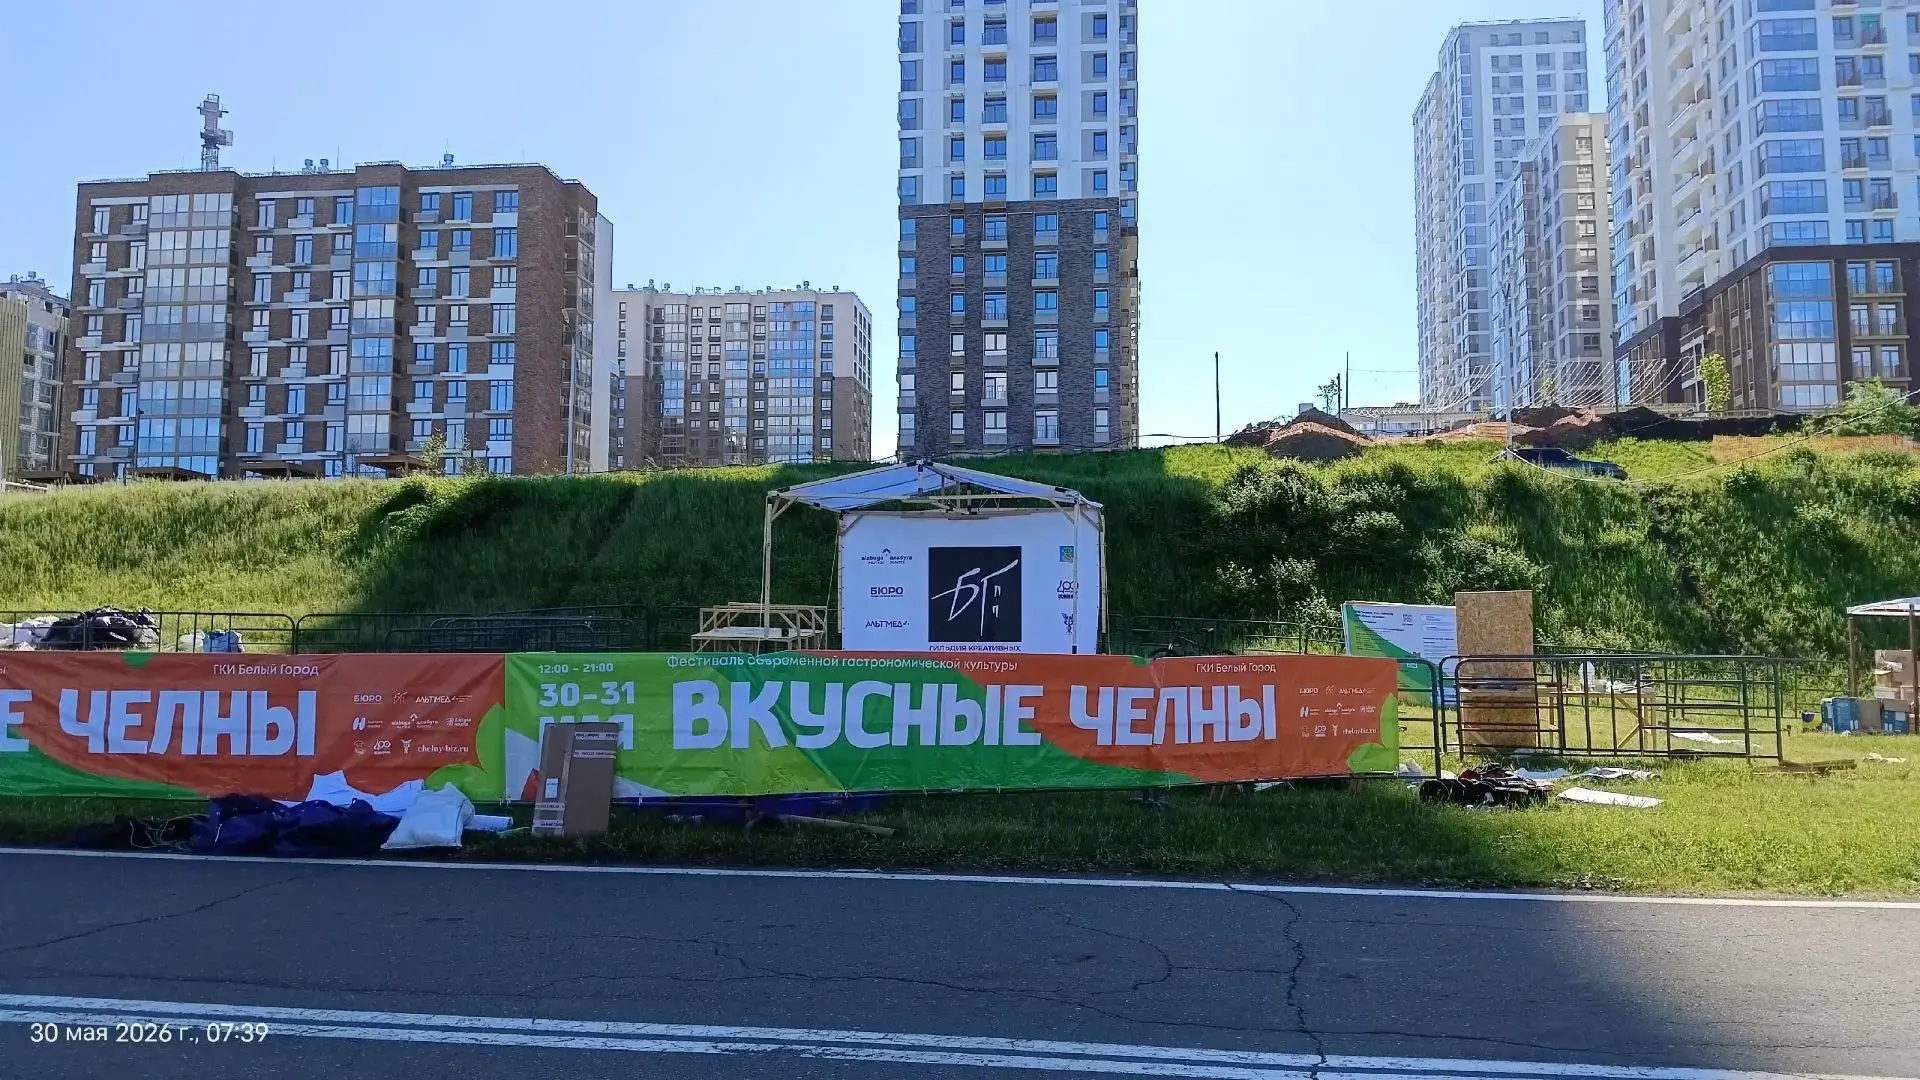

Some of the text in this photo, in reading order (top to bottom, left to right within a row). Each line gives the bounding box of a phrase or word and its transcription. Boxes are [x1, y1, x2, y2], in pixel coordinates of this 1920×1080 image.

[870, 586, 904, 595] БЮРО
[865, 620, 903, 628] АЛЬТМЕД
[213, 663, 319, 677] ГКИ Белый Город
[538, 664, 569, 674] 12:00
[582, 662, 614, 673] 21:00
[667, 655, 1018, 673] Фестиваль современной гастрономической культуры
[1195, 662, 1277, 675] ГКИ Белый Город
[353, 694, 382, 702] БЮРО
[672, 680, 1044, 750] ВКУСНЫЕ
[1069, 684, 1277, 746] ЧЕЛНЫ
[59, 688, 316, 755] ЧЕЛНЫ
[418, 744, 469, 753] chelny-biz.ru
